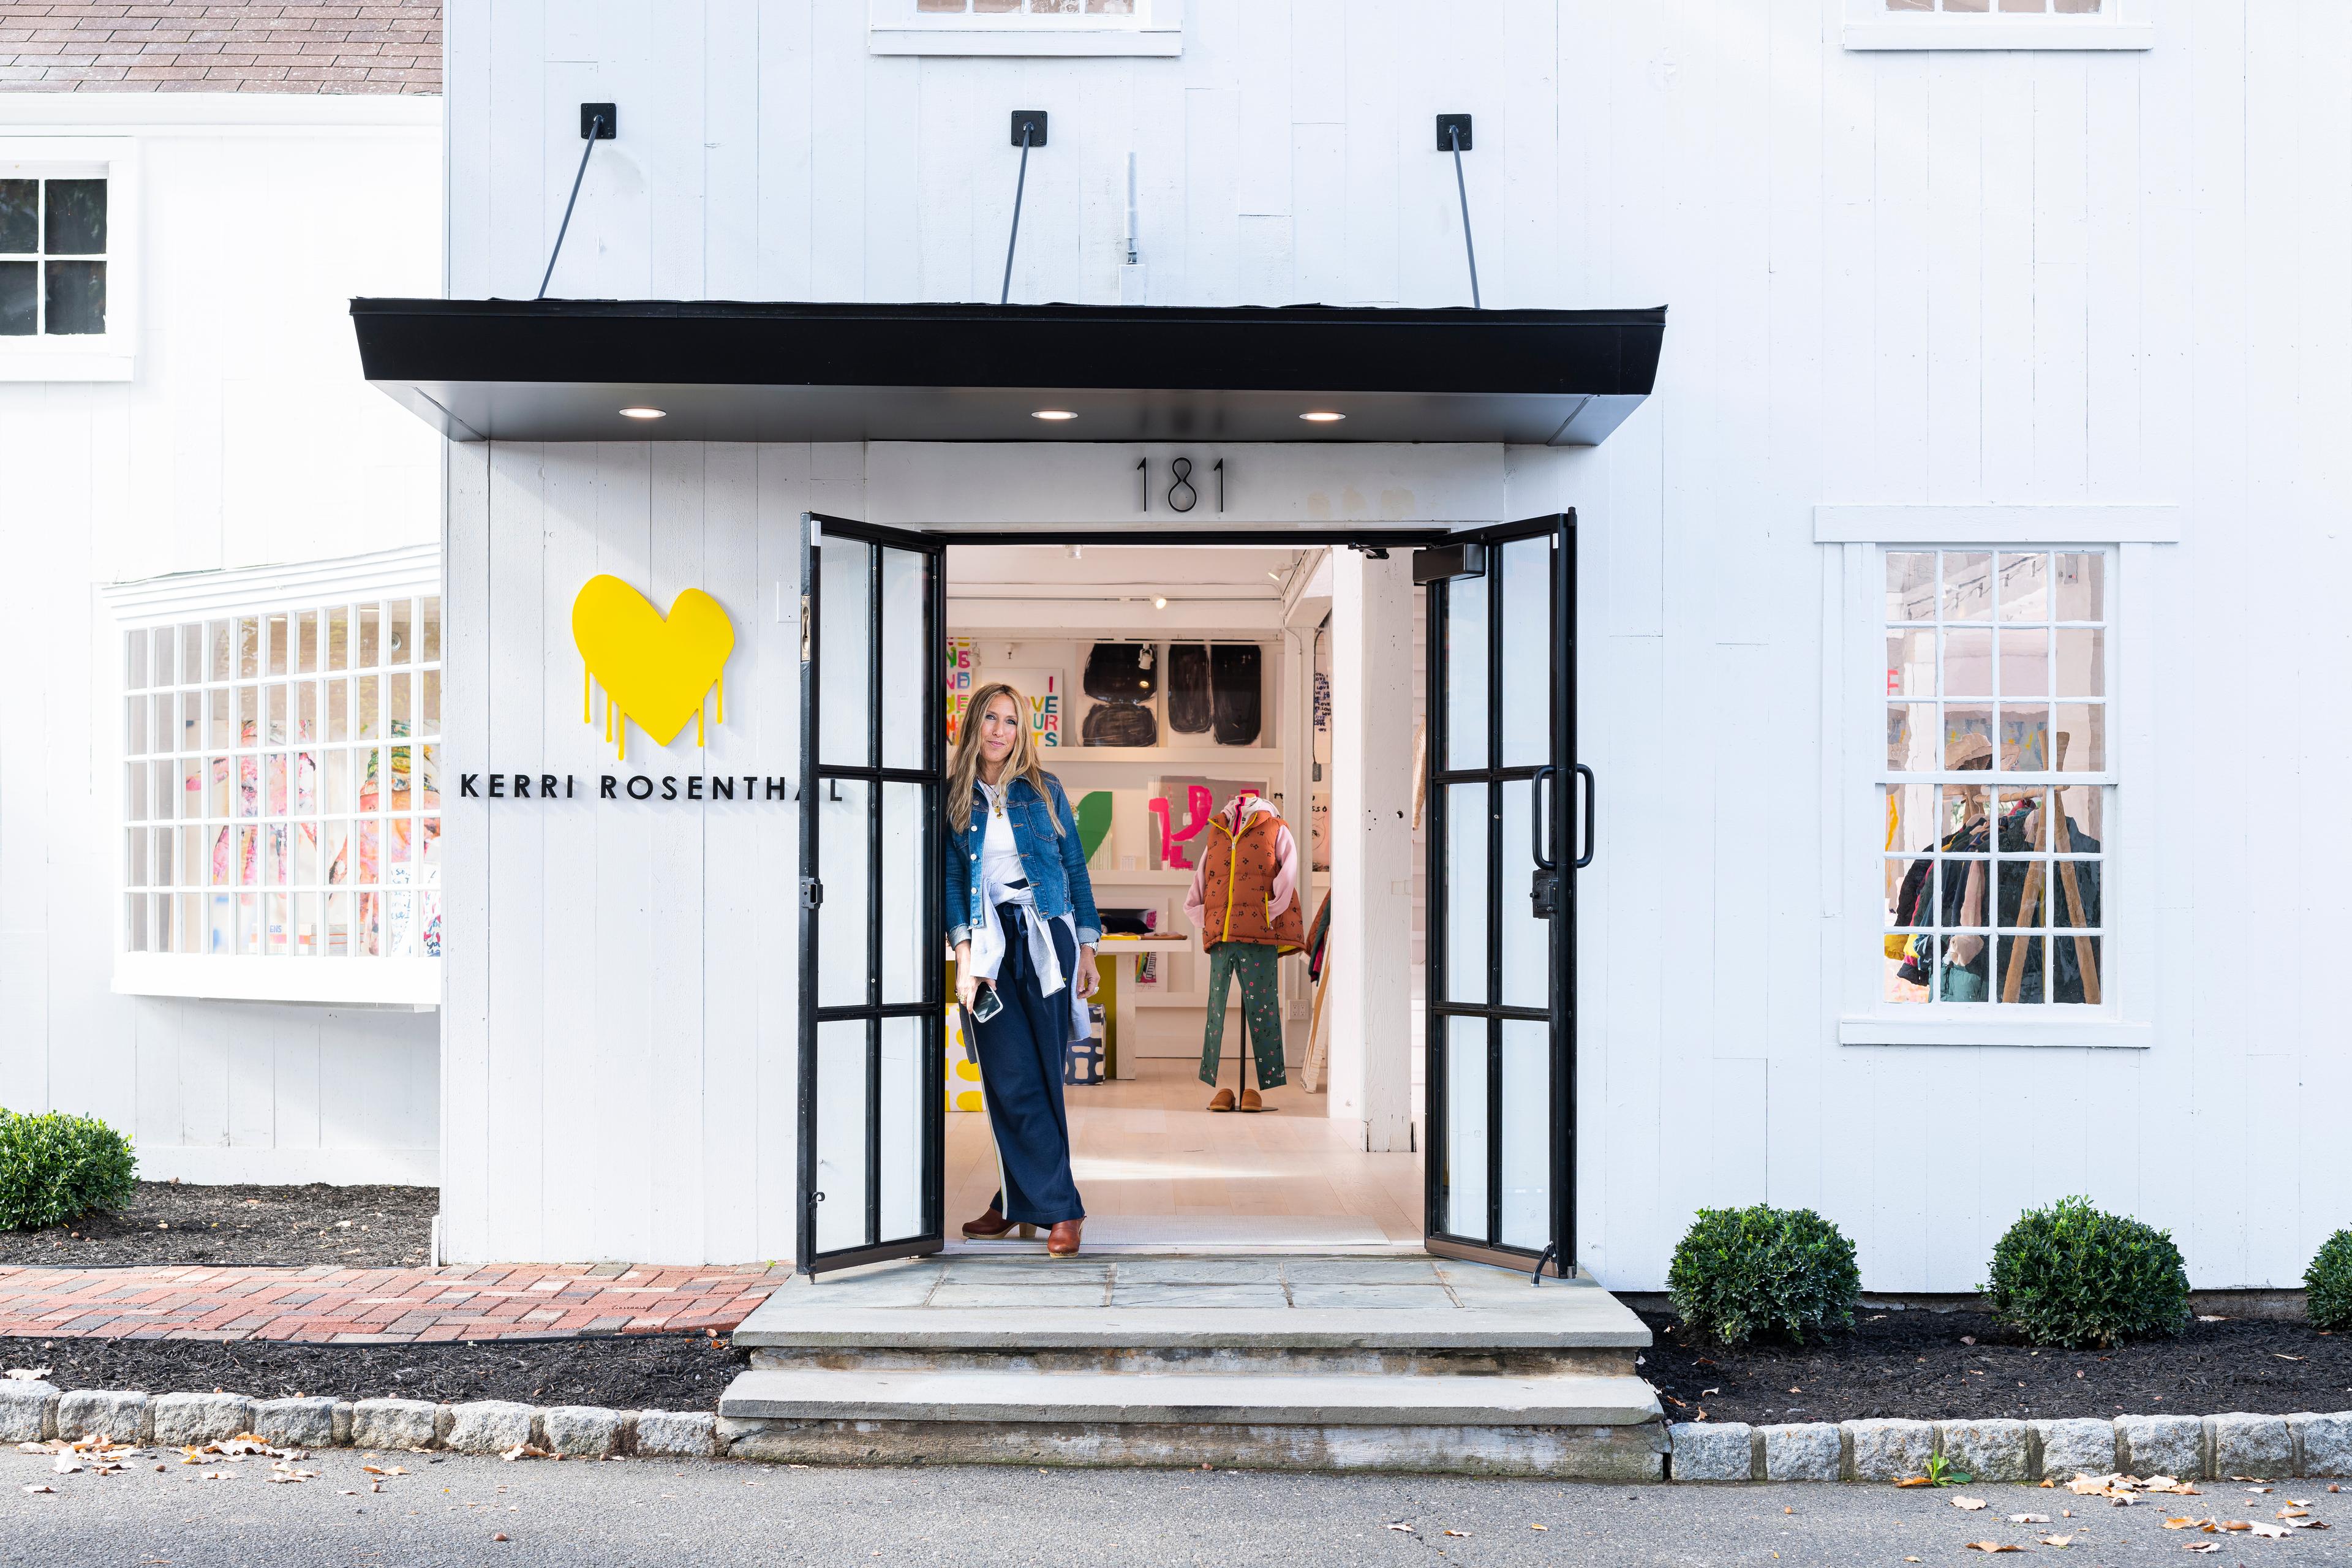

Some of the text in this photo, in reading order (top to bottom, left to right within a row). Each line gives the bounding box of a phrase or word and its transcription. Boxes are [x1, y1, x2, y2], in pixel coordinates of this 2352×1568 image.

[1136, 456, 1224, 513] 181
[461, 774, 842, 802] KERRI ROSENTHL
